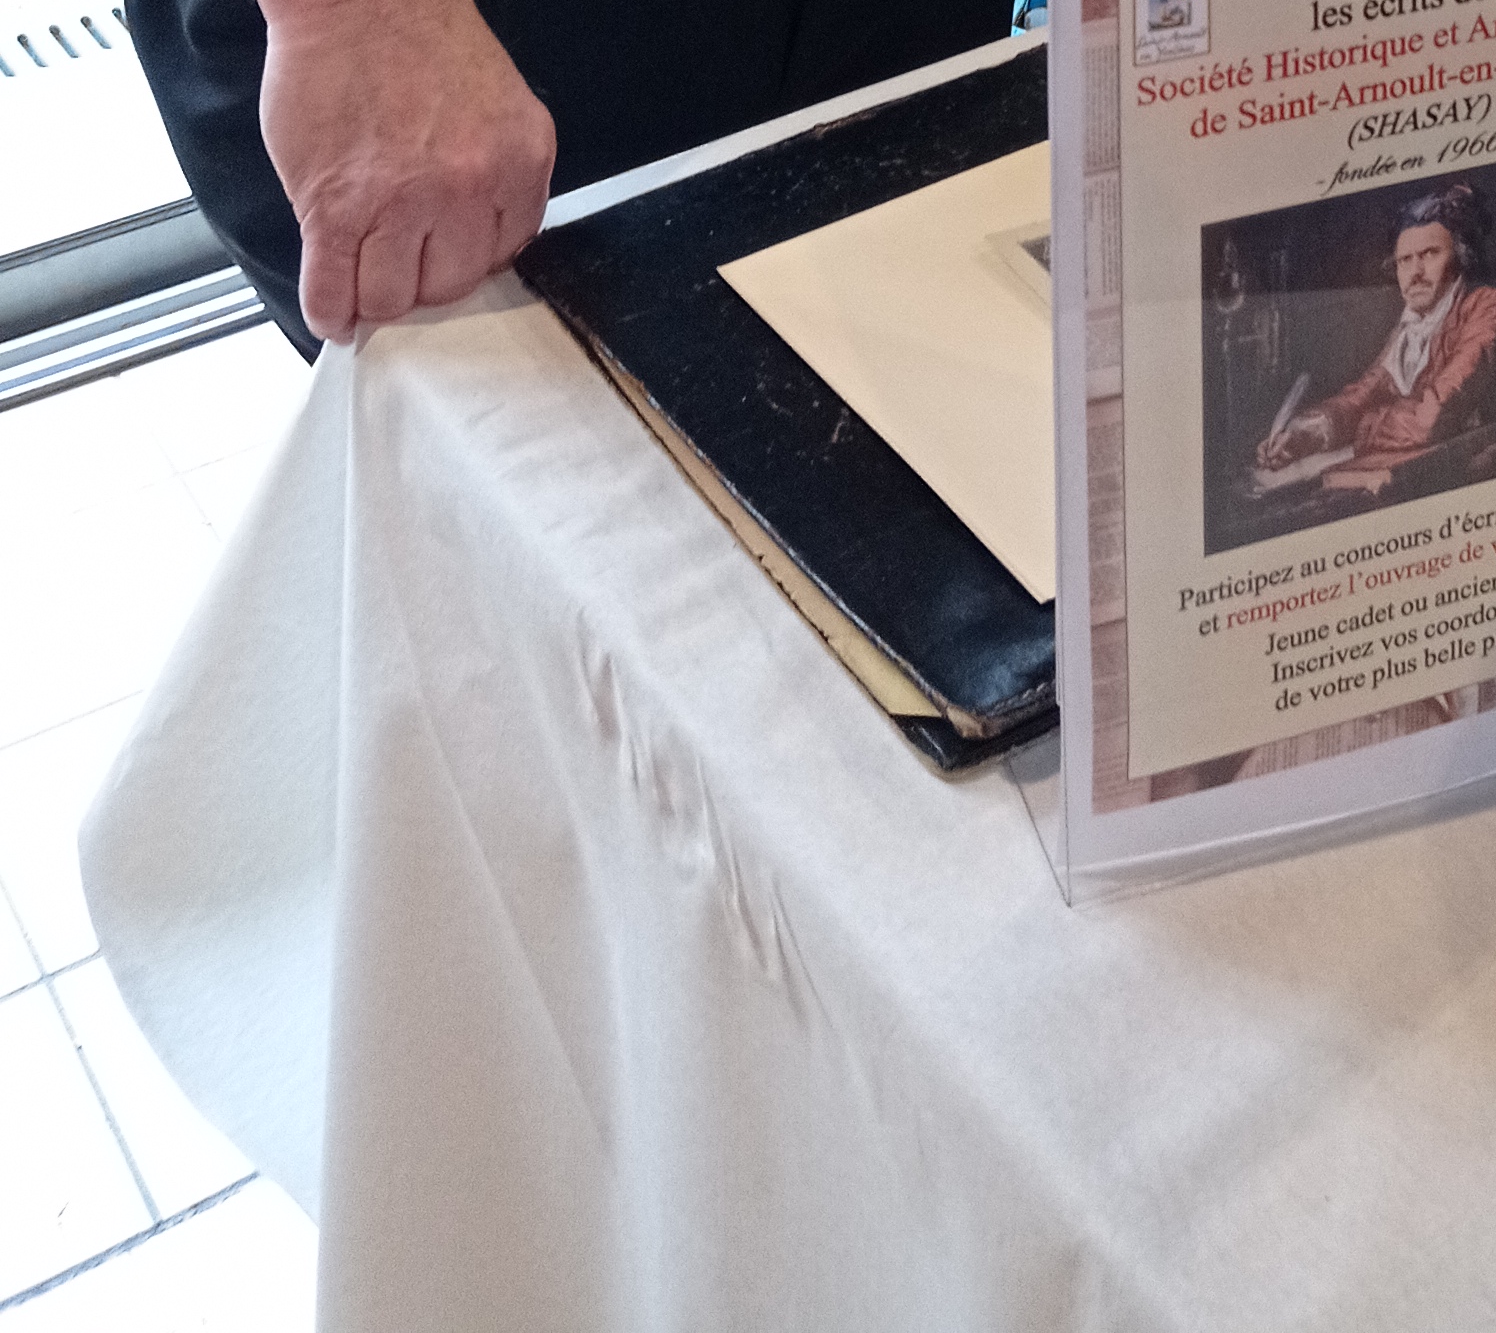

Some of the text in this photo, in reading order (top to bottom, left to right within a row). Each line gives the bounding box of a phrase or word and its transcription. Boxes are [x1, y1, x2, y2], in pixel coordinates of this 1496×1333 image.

[1310, 0, 1354, 31] les
[1136, 59, 1254, 107] Société
[1263, 30, 1424, 84] Historique
[1433, 24, 1460, 49] et
[1190, 106, 1228, 140] de
[1348, 93, 1493, 150] (SHASAY)
[1322, 156, 1397, 195] fondée
[1400, 155, 1425, 171] en
[1178, 565, 1294, 611] Participez
[1300, 557, 1327, 578] au
[1333, 528, 1433, 568] concours
[1198, 613, 1221, 637] et
[1226, 581, 1342, 632] remportez
[1459, 539, 1484, 564] de
[1265, 621, 1331, 657] Jeune
[1336, 601, 1395, 639] cadet
[1400, 598, 1428, 619] ou
[1271, 642, 1375, 684] Inscrivez
[1380, 627, 1418, 652] vos
[1274, 686, 1302, 712] de
[1309, 671, 1366, 703] votre
[1372, 655, 1418, 692] plus
[1424, 640, 1476, 671] belle
